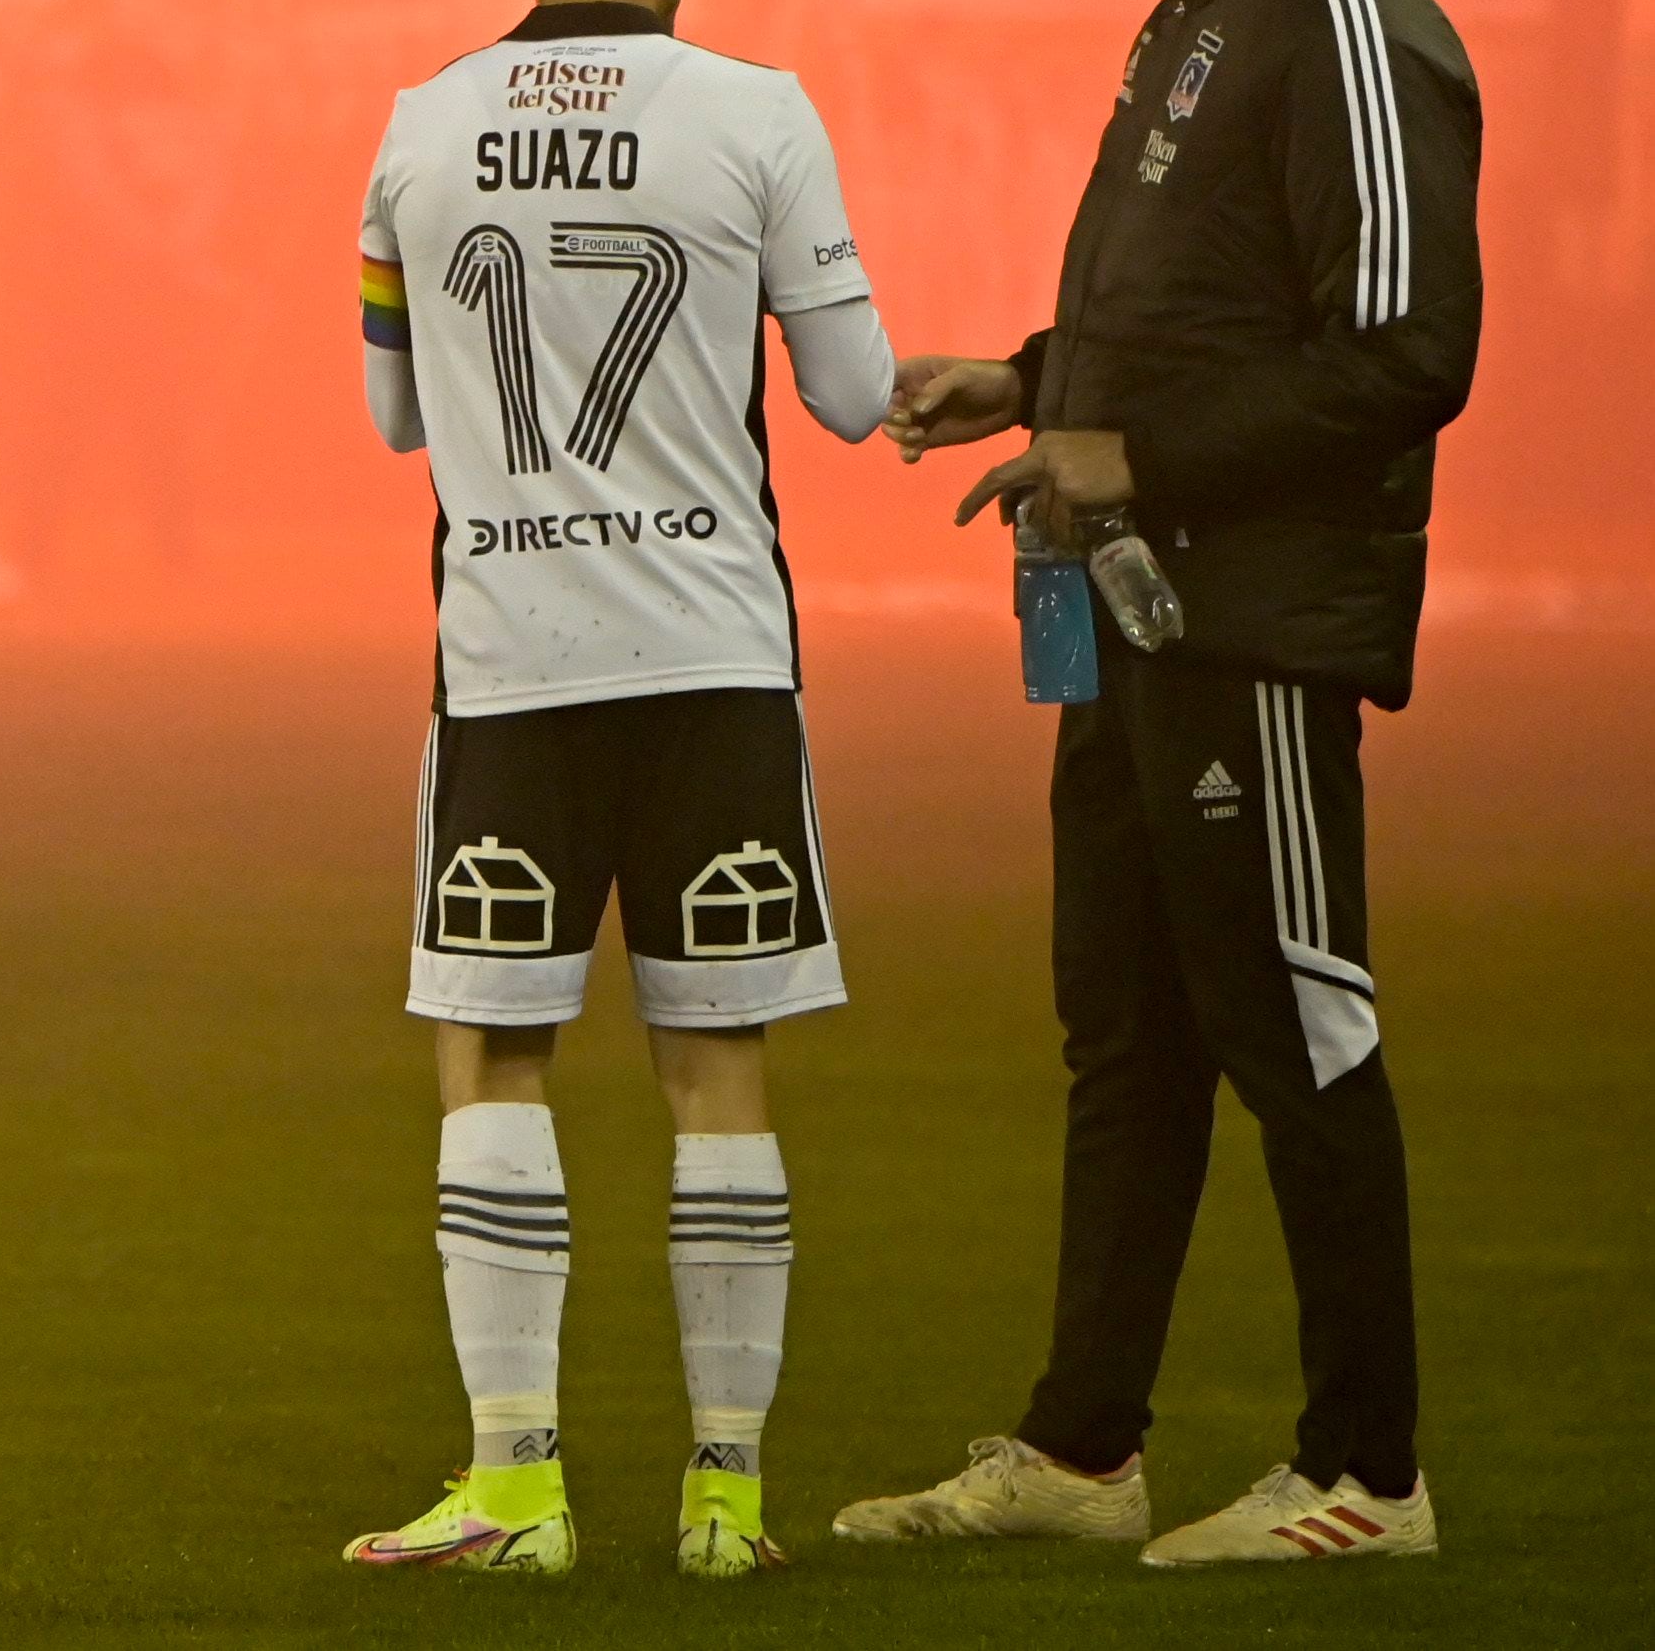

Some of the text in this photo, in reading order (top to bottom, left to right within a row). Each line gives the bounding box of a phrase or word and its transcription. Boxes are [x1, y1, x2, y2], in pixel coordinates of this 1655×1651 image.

[505, 59, 626, 88] Pilsen
[508, 86, 618, 116] del Sur
[477, 128, 639, 192] SUAZO
[442, 221, 688, 476] 17
[468, 506, 718, 556] DIRECTV GO
[1193, 784, 1242, 800] adidas
